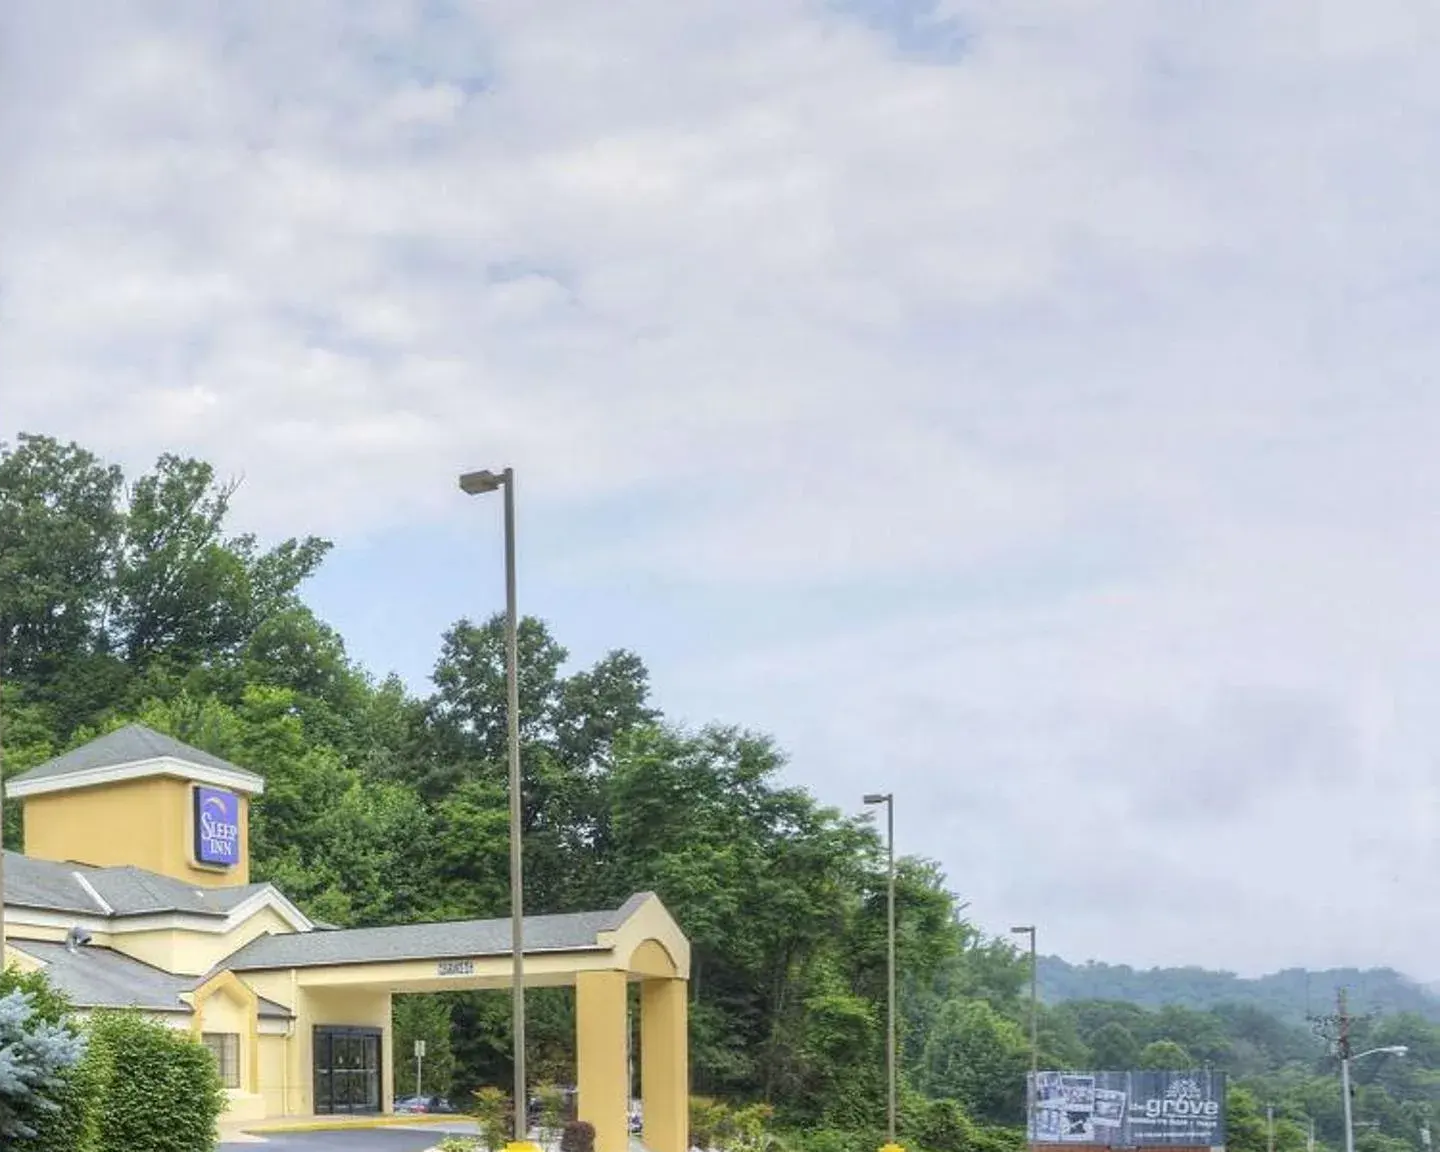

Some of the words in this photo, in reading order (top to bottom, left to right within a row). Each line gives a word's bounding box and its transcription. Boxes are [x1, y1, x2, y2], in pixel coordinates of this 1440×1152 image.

[201, 812, 237, 841] SLEEP
[210, 839, 232, 856] INN
[1145, 1099, 1219, 1118] grove
